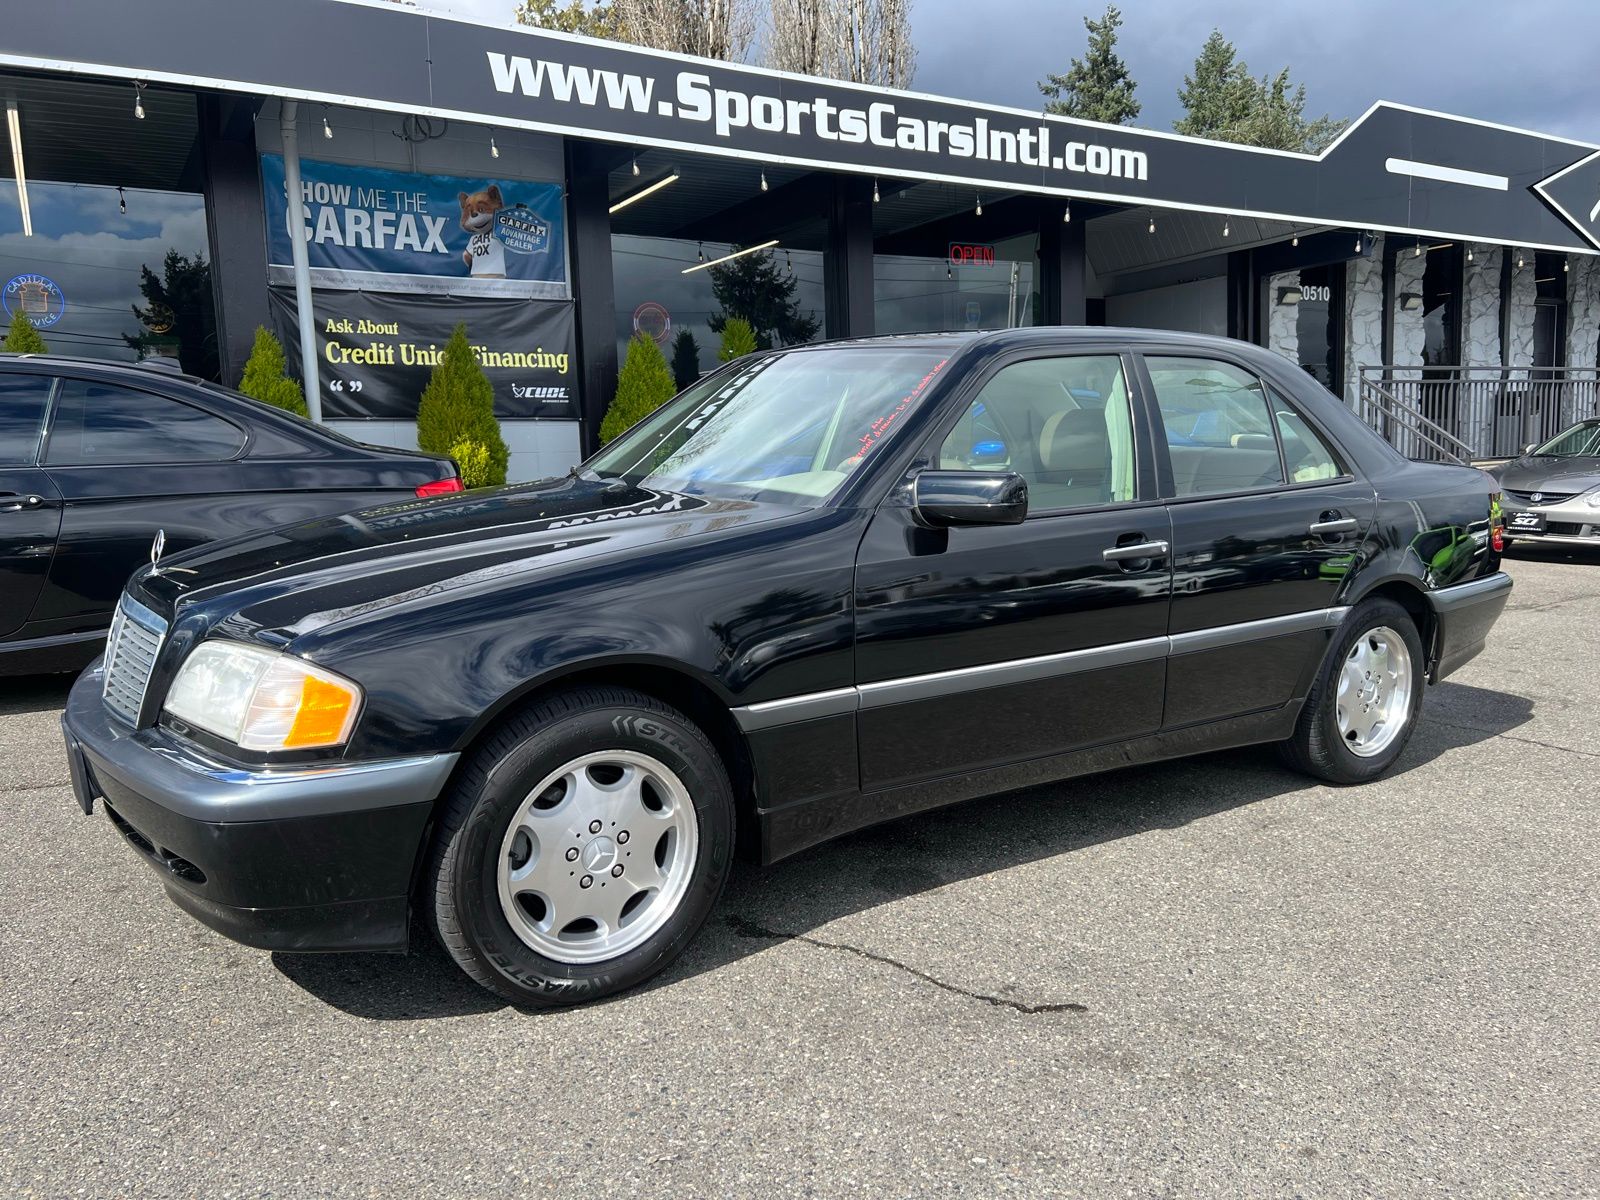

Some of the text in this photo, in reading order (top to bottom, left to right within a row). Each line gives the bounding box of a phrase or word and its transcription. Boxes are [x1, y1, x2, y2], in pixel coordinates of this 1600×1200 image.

[486, 51, 1148, 181] www.SportsCarsIntl.com
[357, 187, 388, 210] ME
[391, 190, 428, 214] THE
[499, 215, 546, 237] CARFAX
[501, 226, 541, 245] ADVANTAGE
[472, 233, 492, 246] CAR
[504, 238, 533, 251] DEALER
[473, 244, 490, 257] FOX
[951, 246, 994, 267] OPEN
[7, 275, 58, 296] CADILLAC
[325, 319, 399, 335] Ask About
[325, 341, 395, 365] Credit
[399, 343, 448, 366] Unio
[525, 387, 569, 398] CUDL
